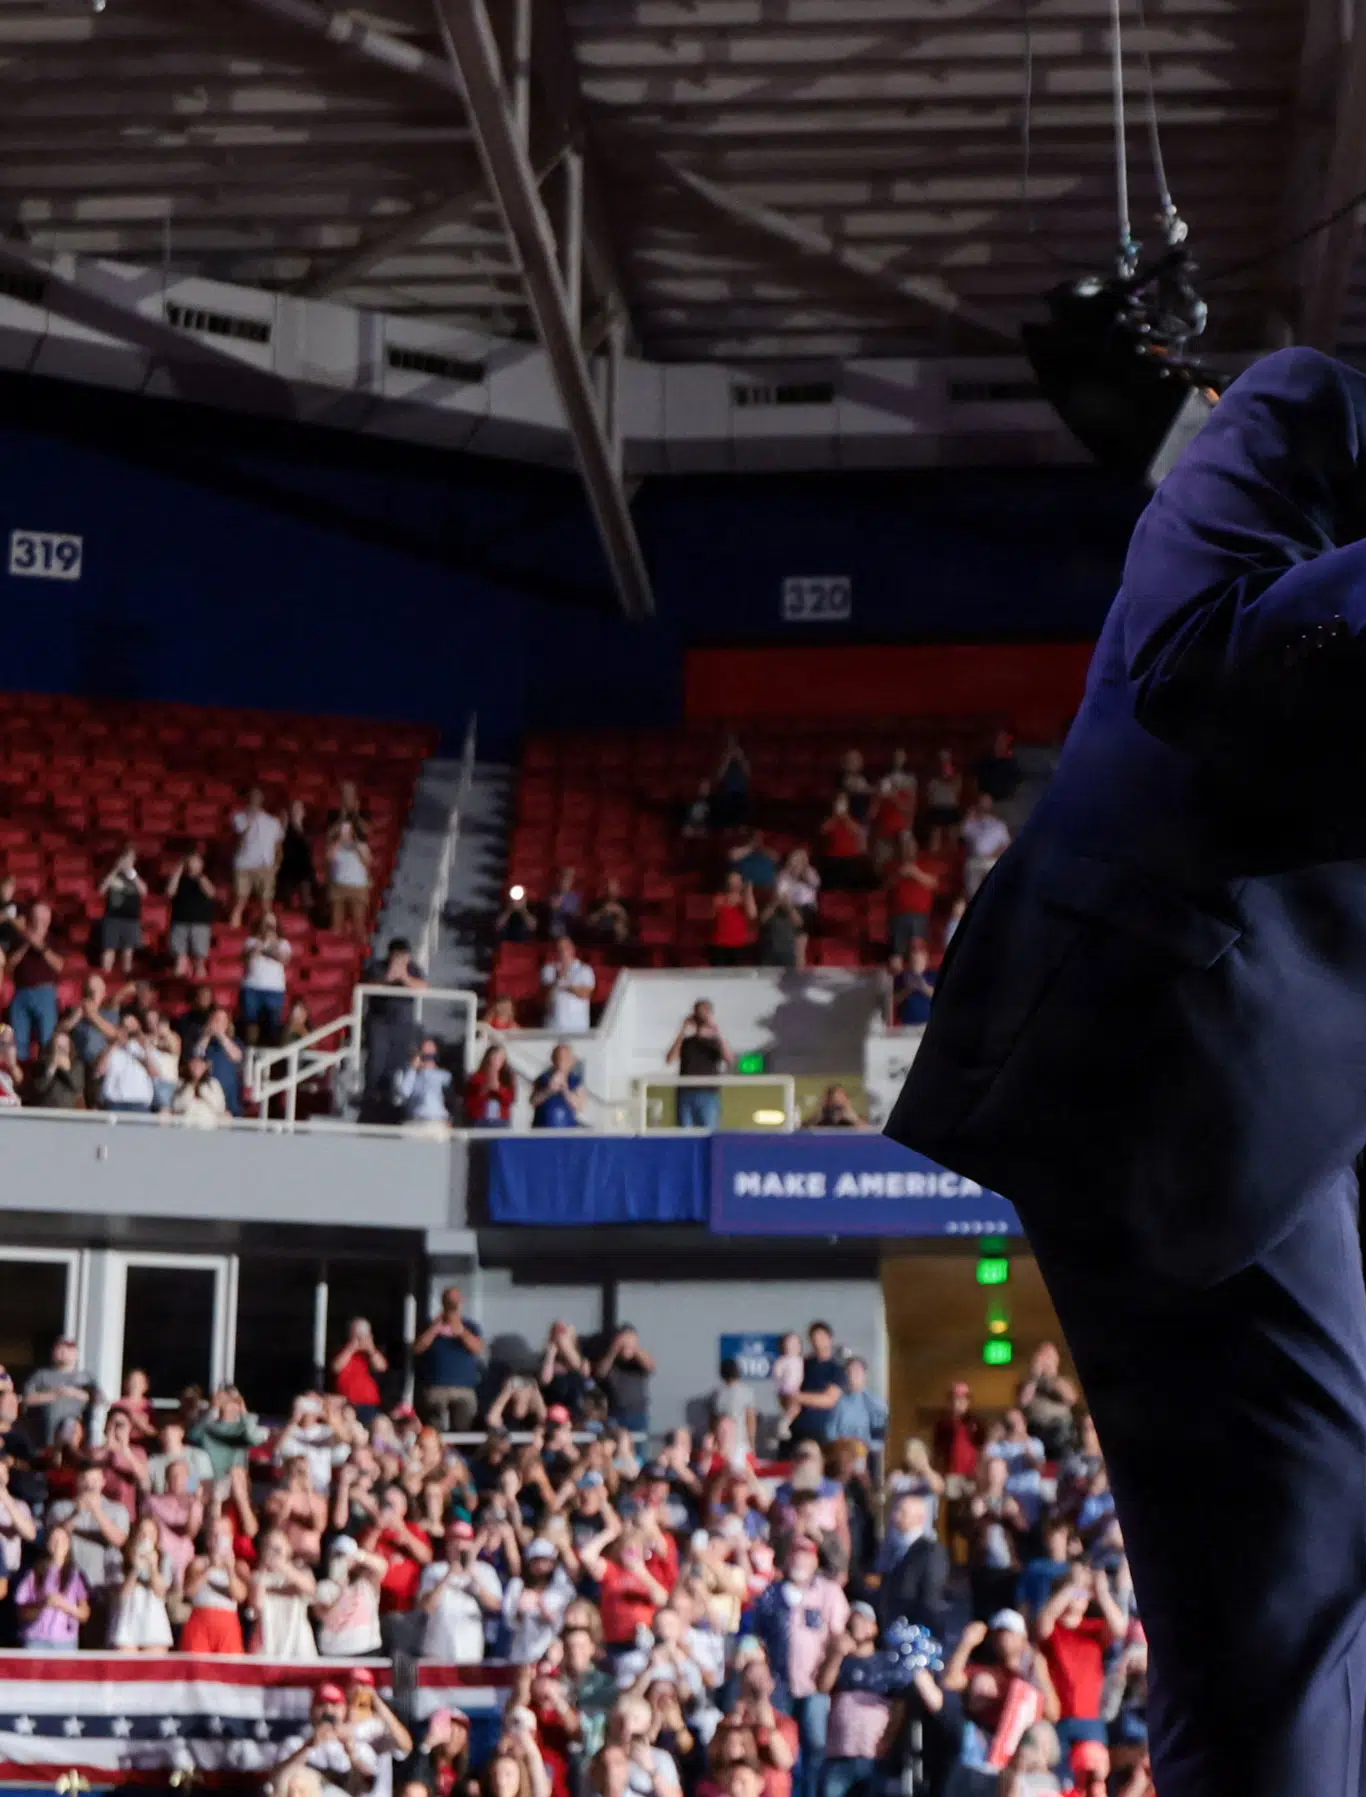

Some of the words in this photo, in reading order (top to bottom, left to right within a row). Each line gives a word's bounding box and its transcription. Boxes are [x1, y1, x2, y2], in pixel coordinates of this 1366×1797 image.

[14, 537, 80, 571] 319
[788, 583, 850, 614] 320
[734, 1172, 826, 1198] MAKE
[833, 1172, 984, 1198] AMERICA
